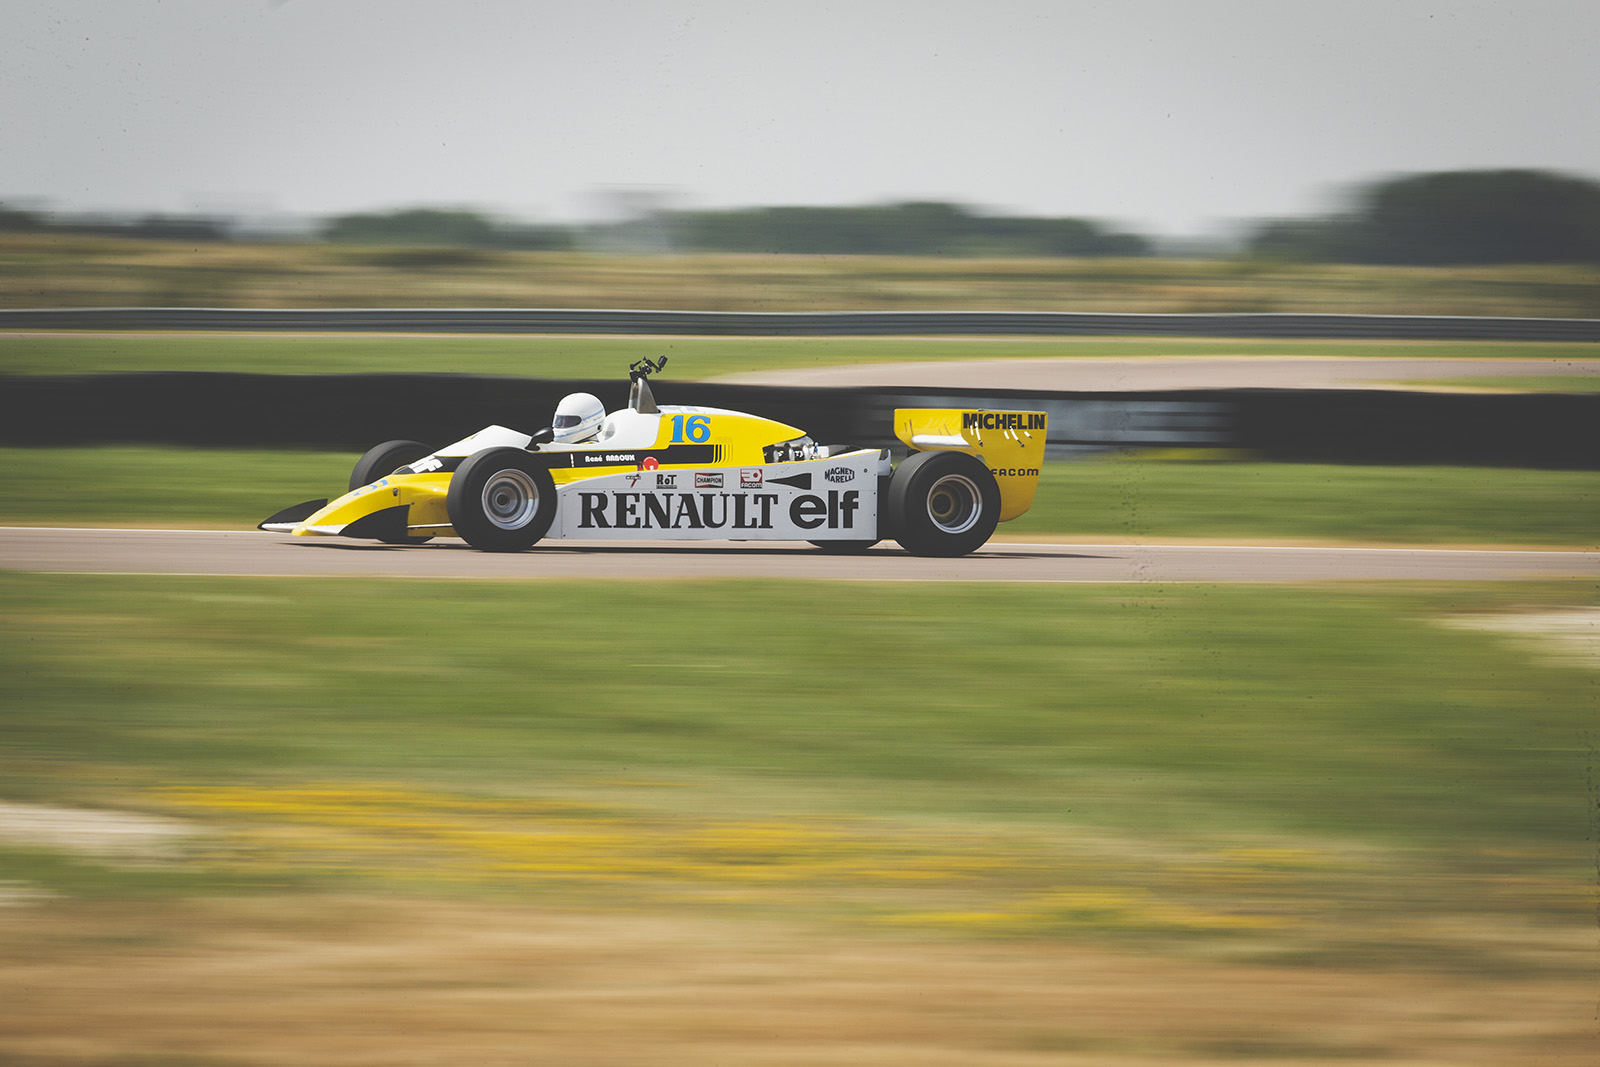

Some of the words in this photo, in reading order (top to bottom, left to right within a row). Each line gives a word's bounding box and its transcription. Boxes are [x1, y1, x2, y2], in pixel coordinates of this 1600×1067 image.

[669, 415, 711, 443] 16
[963, 413, 1045, 430] MICHELIN
[825, 467, 855, 479] MAGNETI
[991, 468, 1039, 476] FACOM
[577, 492, 778, 529] RENAULT
[789, 490, 859, 530] elf
